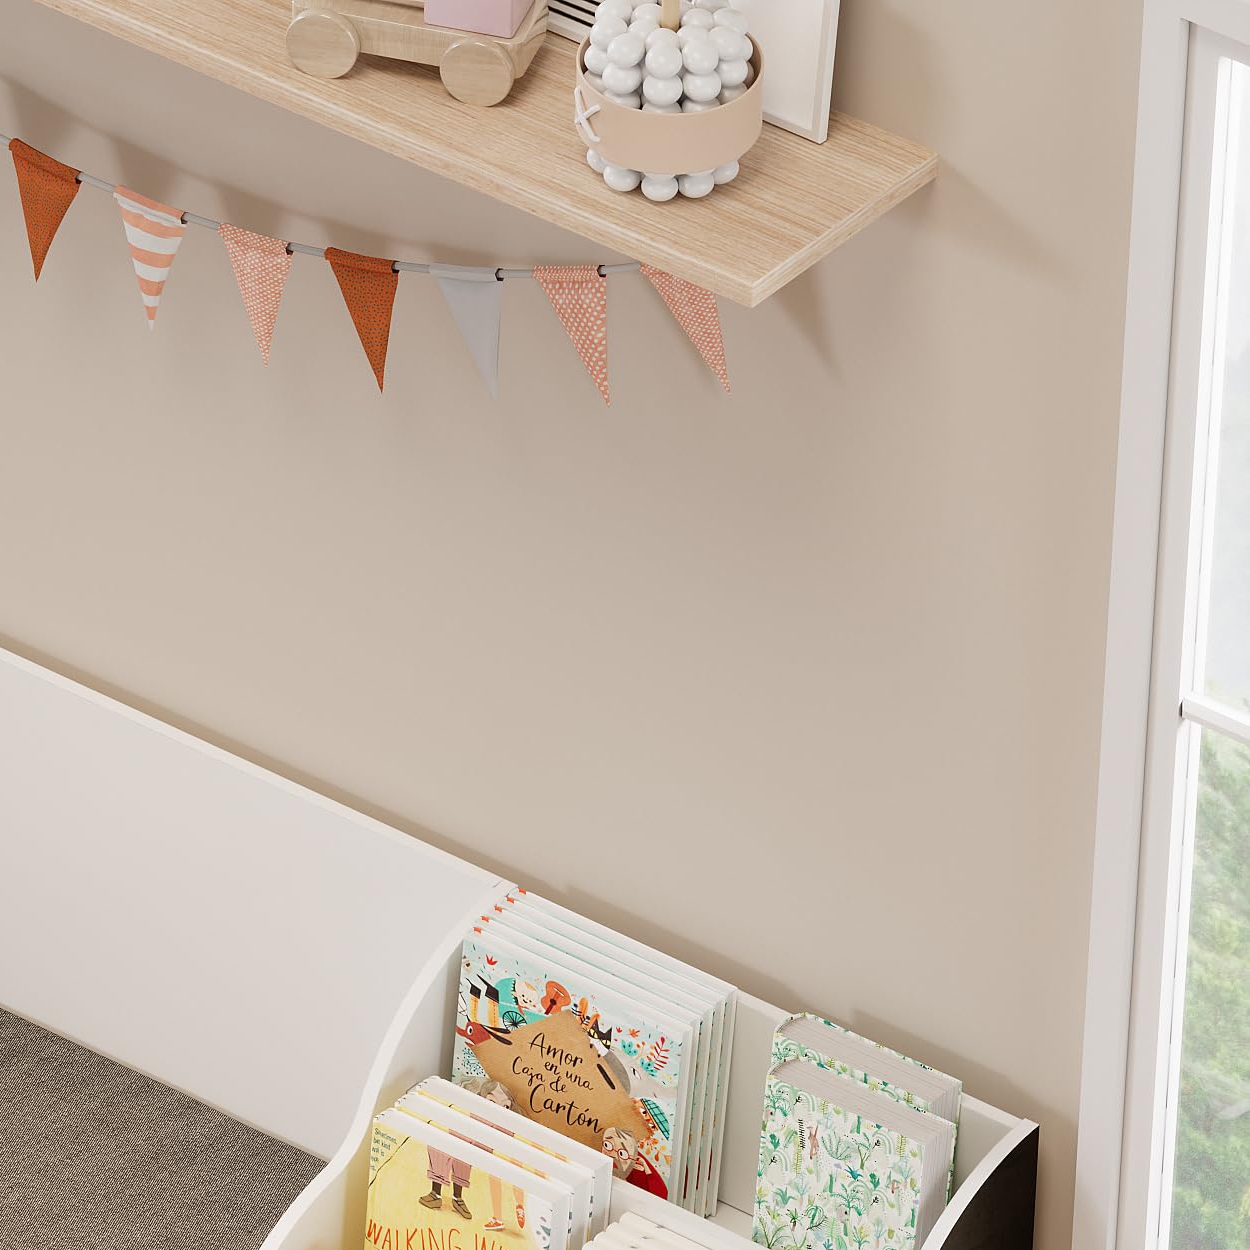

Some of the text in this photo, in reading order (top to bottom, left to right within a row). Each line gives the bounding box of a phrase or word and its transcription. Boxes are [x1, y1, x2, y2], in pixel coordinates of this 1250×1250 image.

[529, 1032, 583, 1067] Amor
[512, 1056, 568, 1092] Caja de
[544, 1061, 593, 1091] en una
[529, 1083, 604, 1134] Cartón
